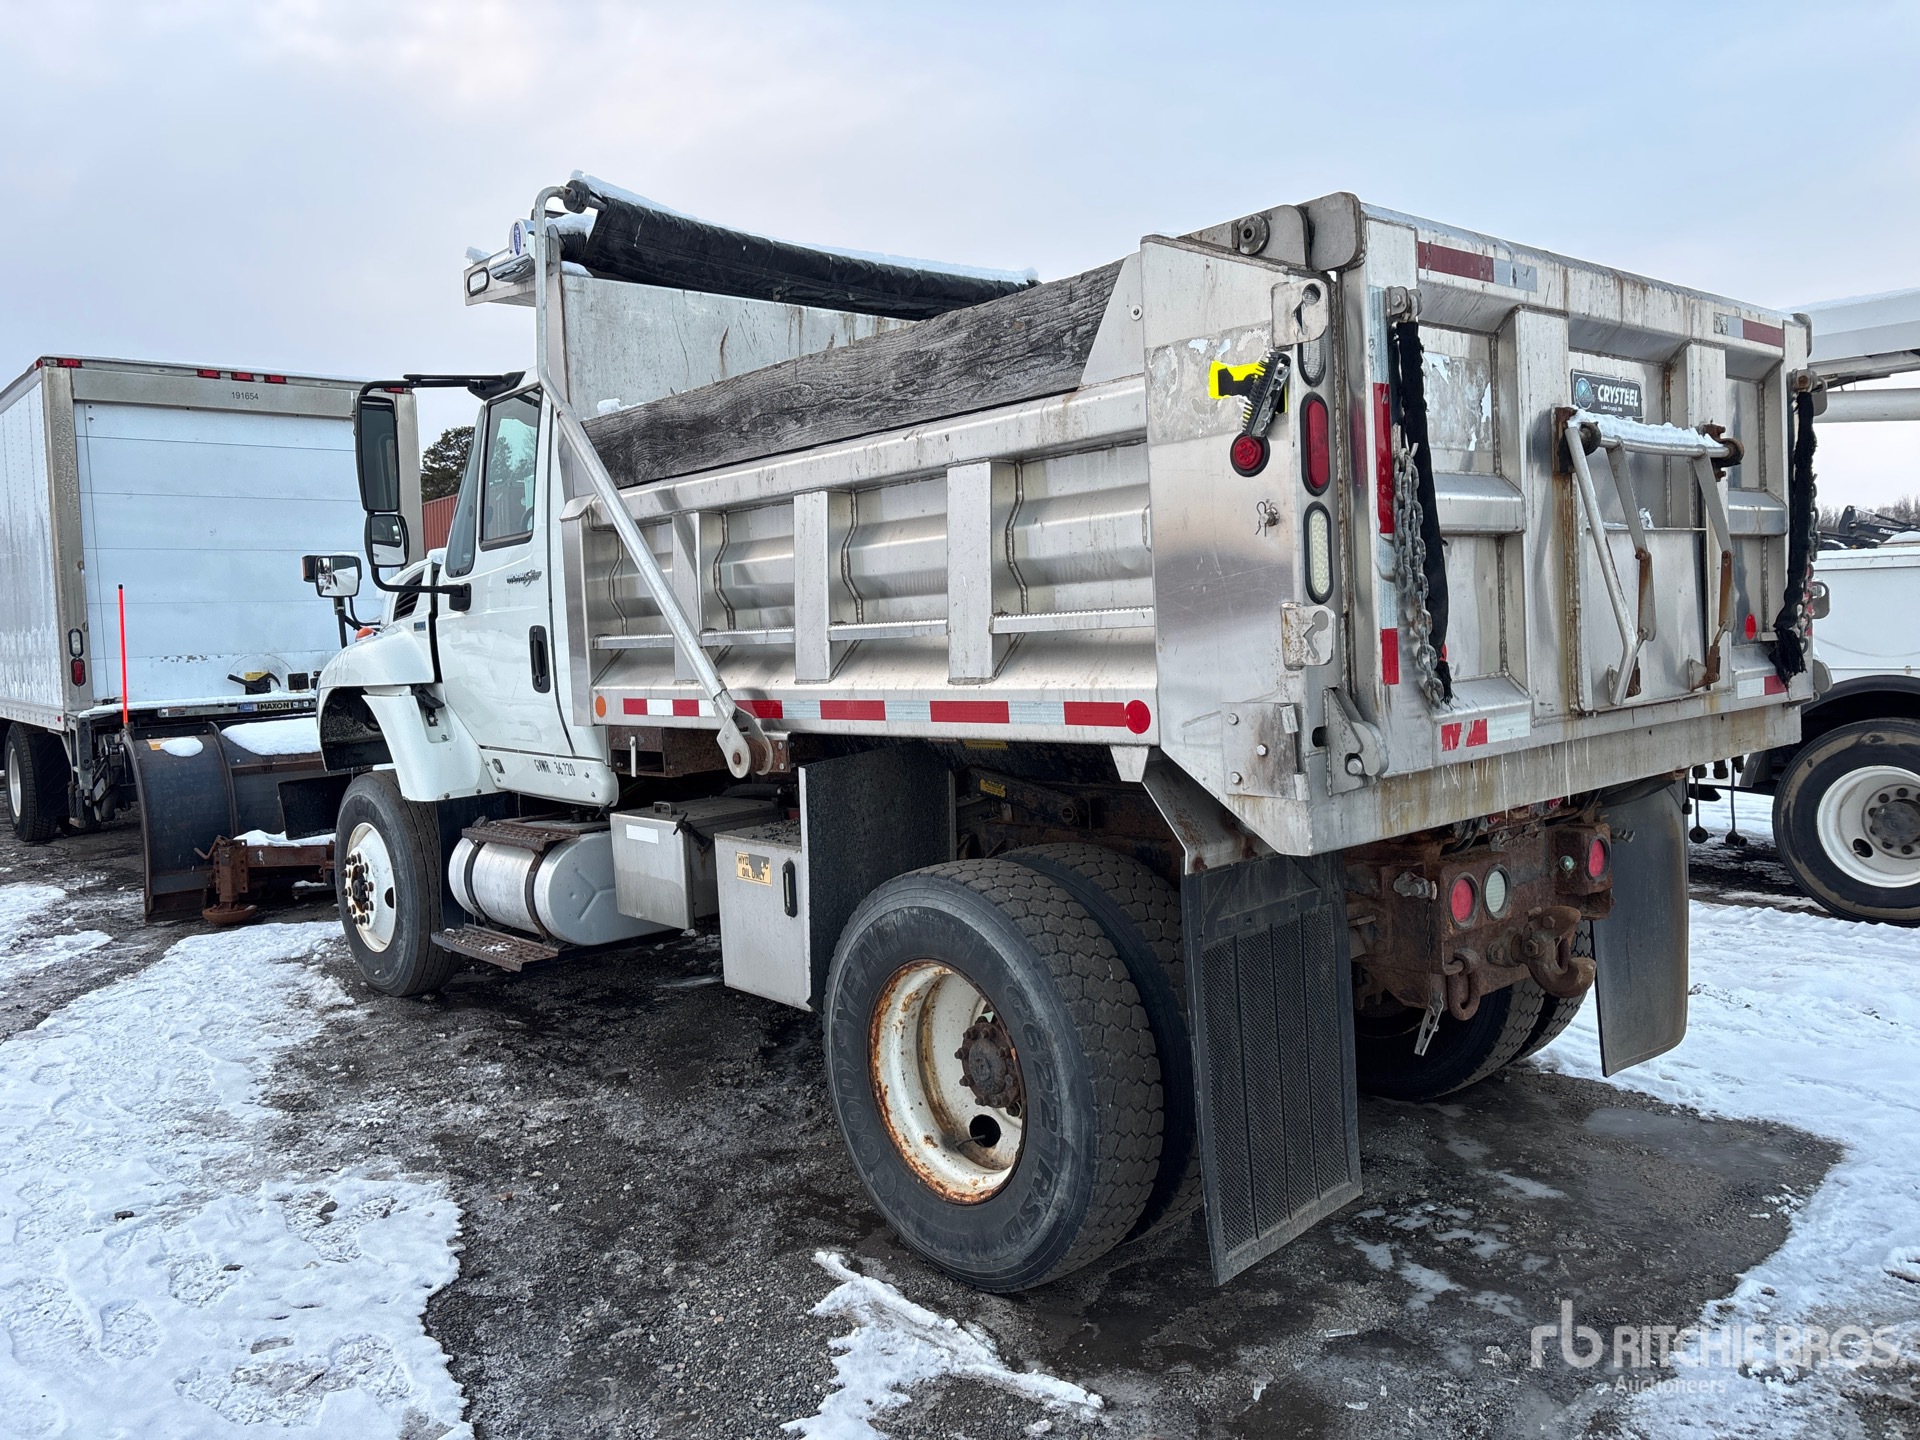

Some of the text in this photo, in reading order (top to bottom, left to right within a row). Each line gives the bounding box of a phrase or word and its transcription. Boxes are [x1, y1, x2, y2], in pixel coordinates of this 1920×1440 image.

[231, 391, 259, 400] 191654
[1598, 385, 1639, 406] CRYSTEEL
[260, 703, 290, 711] MAXON
[534, 759, 551, 773] GVWR
[742, 867, 751, 878] OIL
